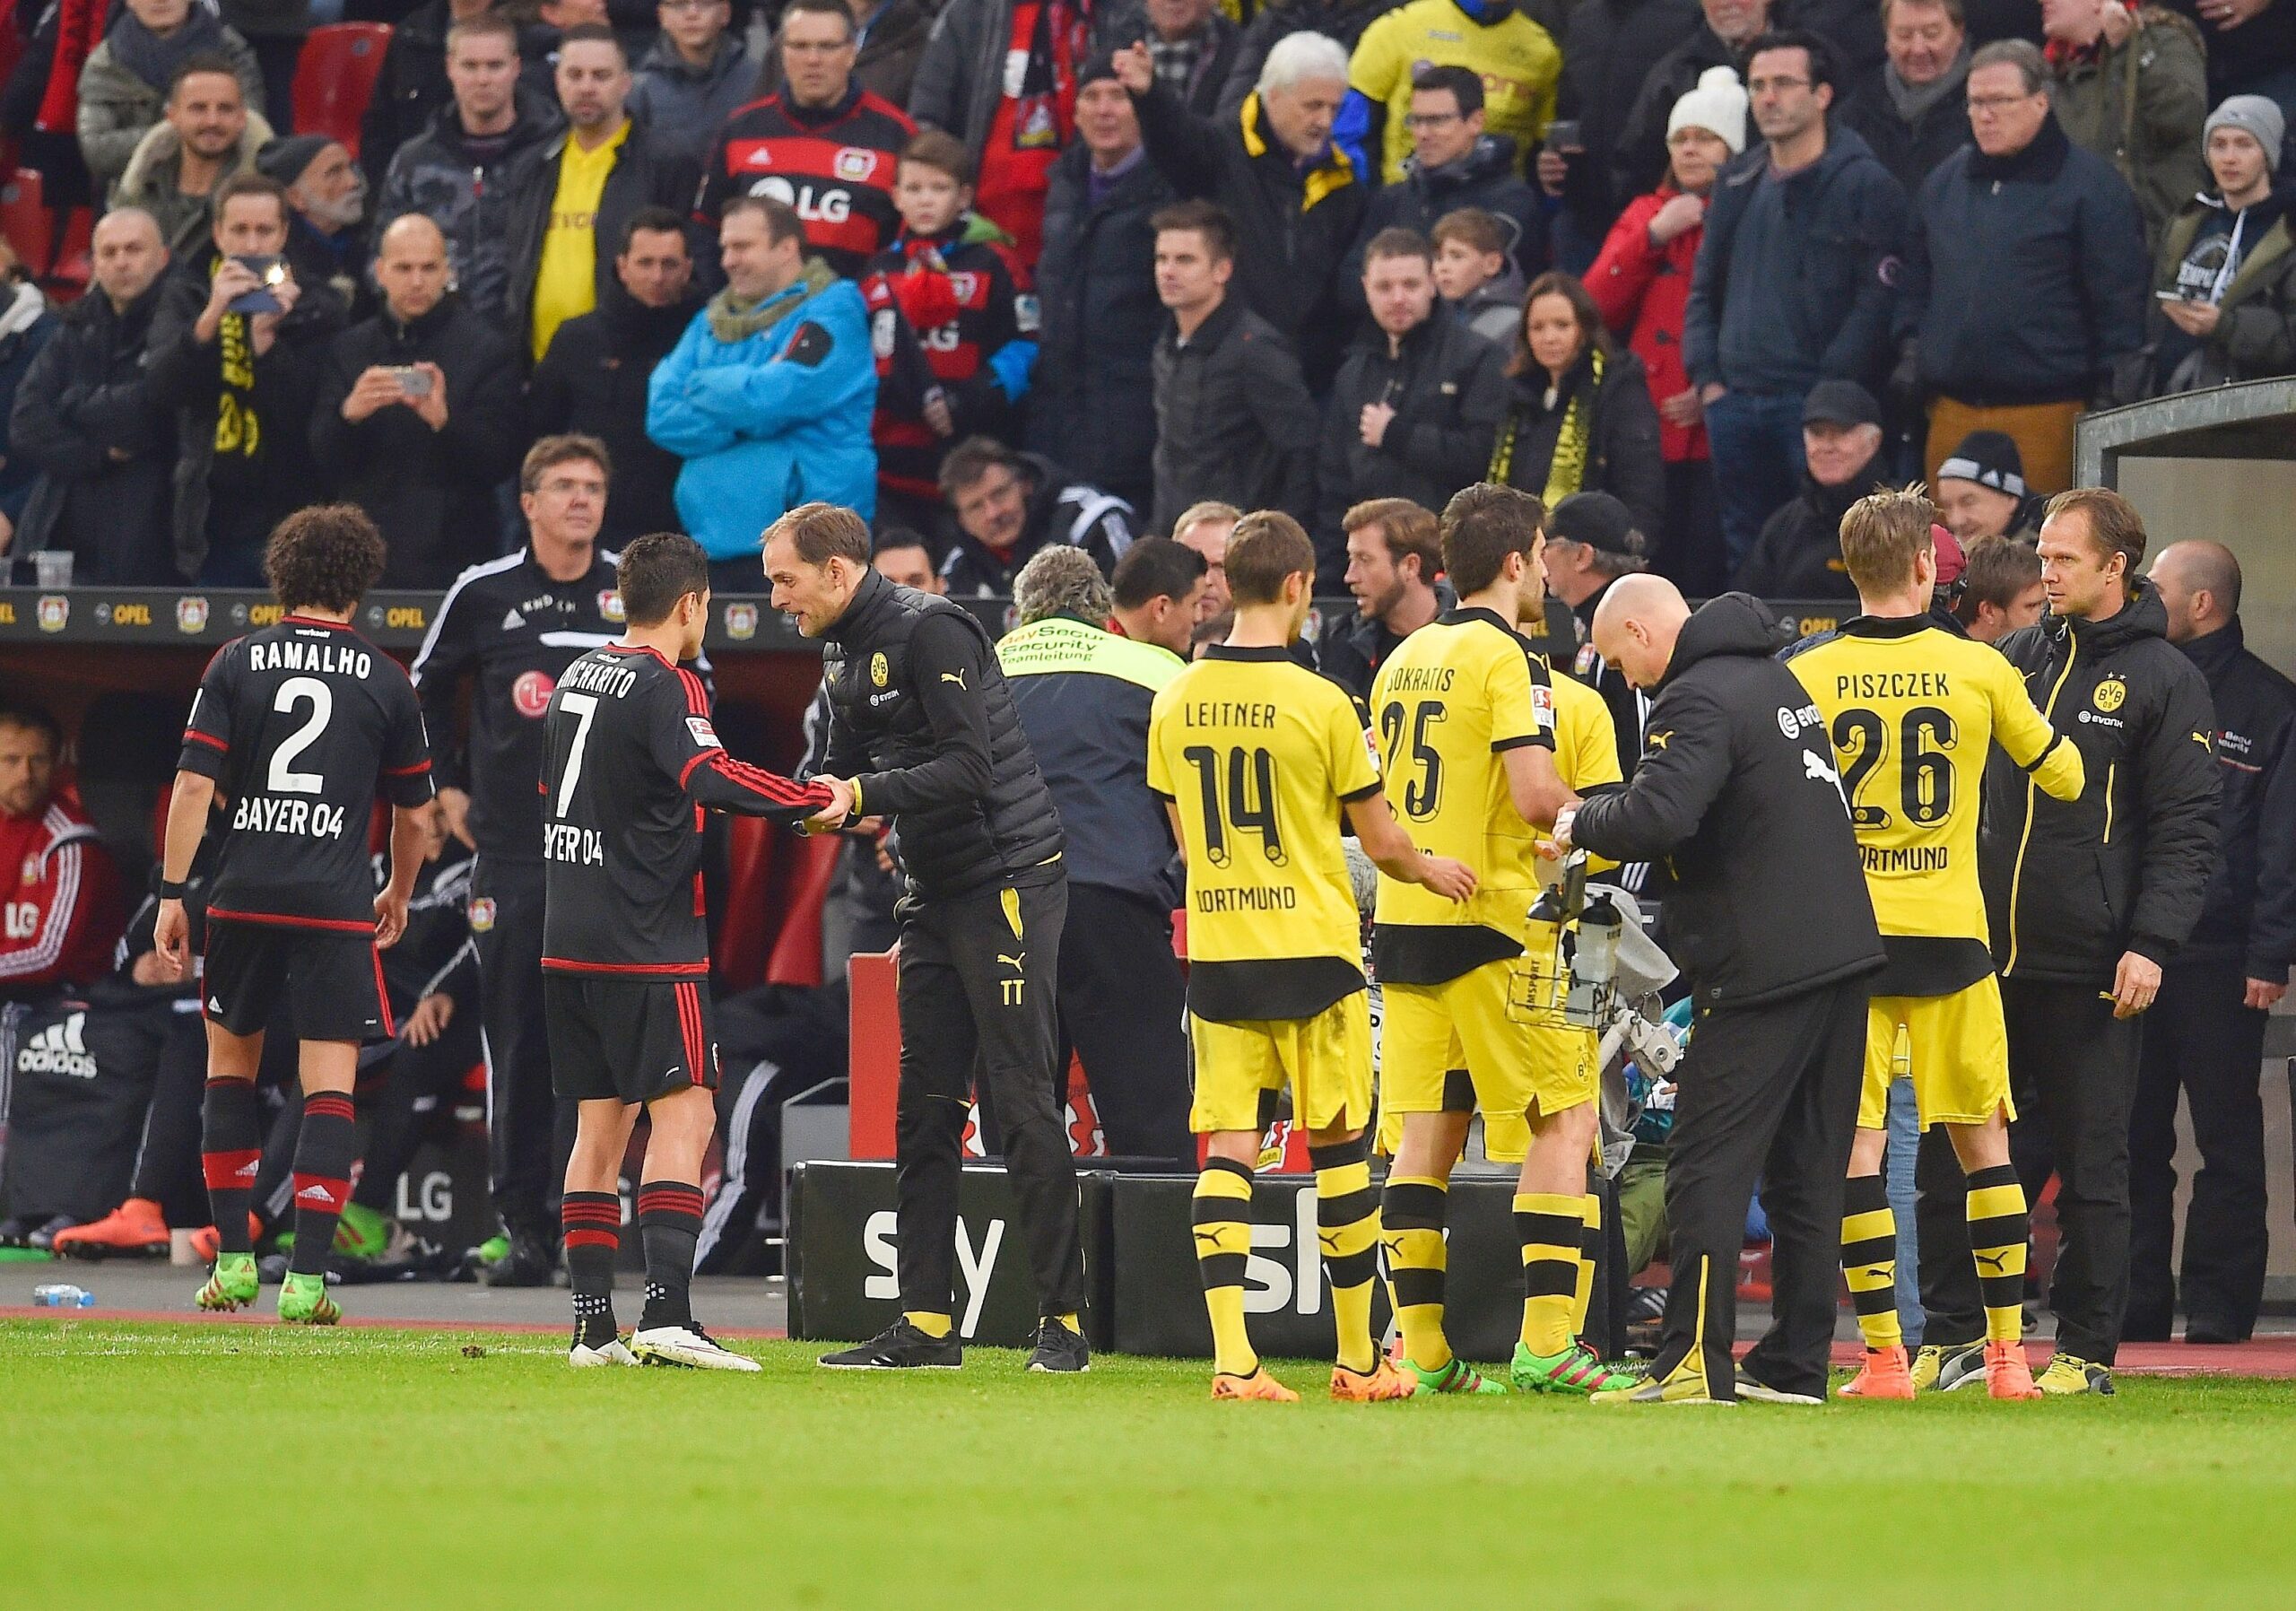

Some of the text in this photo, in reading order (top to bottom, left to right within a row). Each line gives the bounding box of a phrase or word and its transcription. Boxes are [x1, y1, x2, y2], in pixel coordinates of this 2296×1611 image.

[797, 186, 852, 223] LG
[113, 604, 152, 626] OPEL
[249, 604, 285, 625] OPE
[387, 607, 425, 628] OPEL
[250, 641, 371, 680] RAMALHO
[1000, 650, 1093, 665] Teamleitung
[1002, 640, 1096, 657] Security
[1387, 667, 1455, 692] SOKRATIS
[1838, 673, 1950, 700] PISZCZEK
[2099, 684, 2123, 703] BVB
[1186, 702, 1276, 728] LEITNER
[266, 676, 333, 795] 2
[556, 691, 600, 819] 7
[1381, 701, 1448, 823] 25
[1832, 707, 1959, 830] 26
[233, 797, 345, 840] BAYER 04
[1183, 745, 1289, 869] 14
[544, 823, 604, 867] YER 04
[1857, 844, 1949, 872] ORTMUND
[5, 901, 41, 939] LG
[1000, 980, 1025, 1006] TT
[18, 1048, 98, 1080] adidas
[396, 1171, 452, 1222] LG
[863, 1210, 1005, 1338] sy
